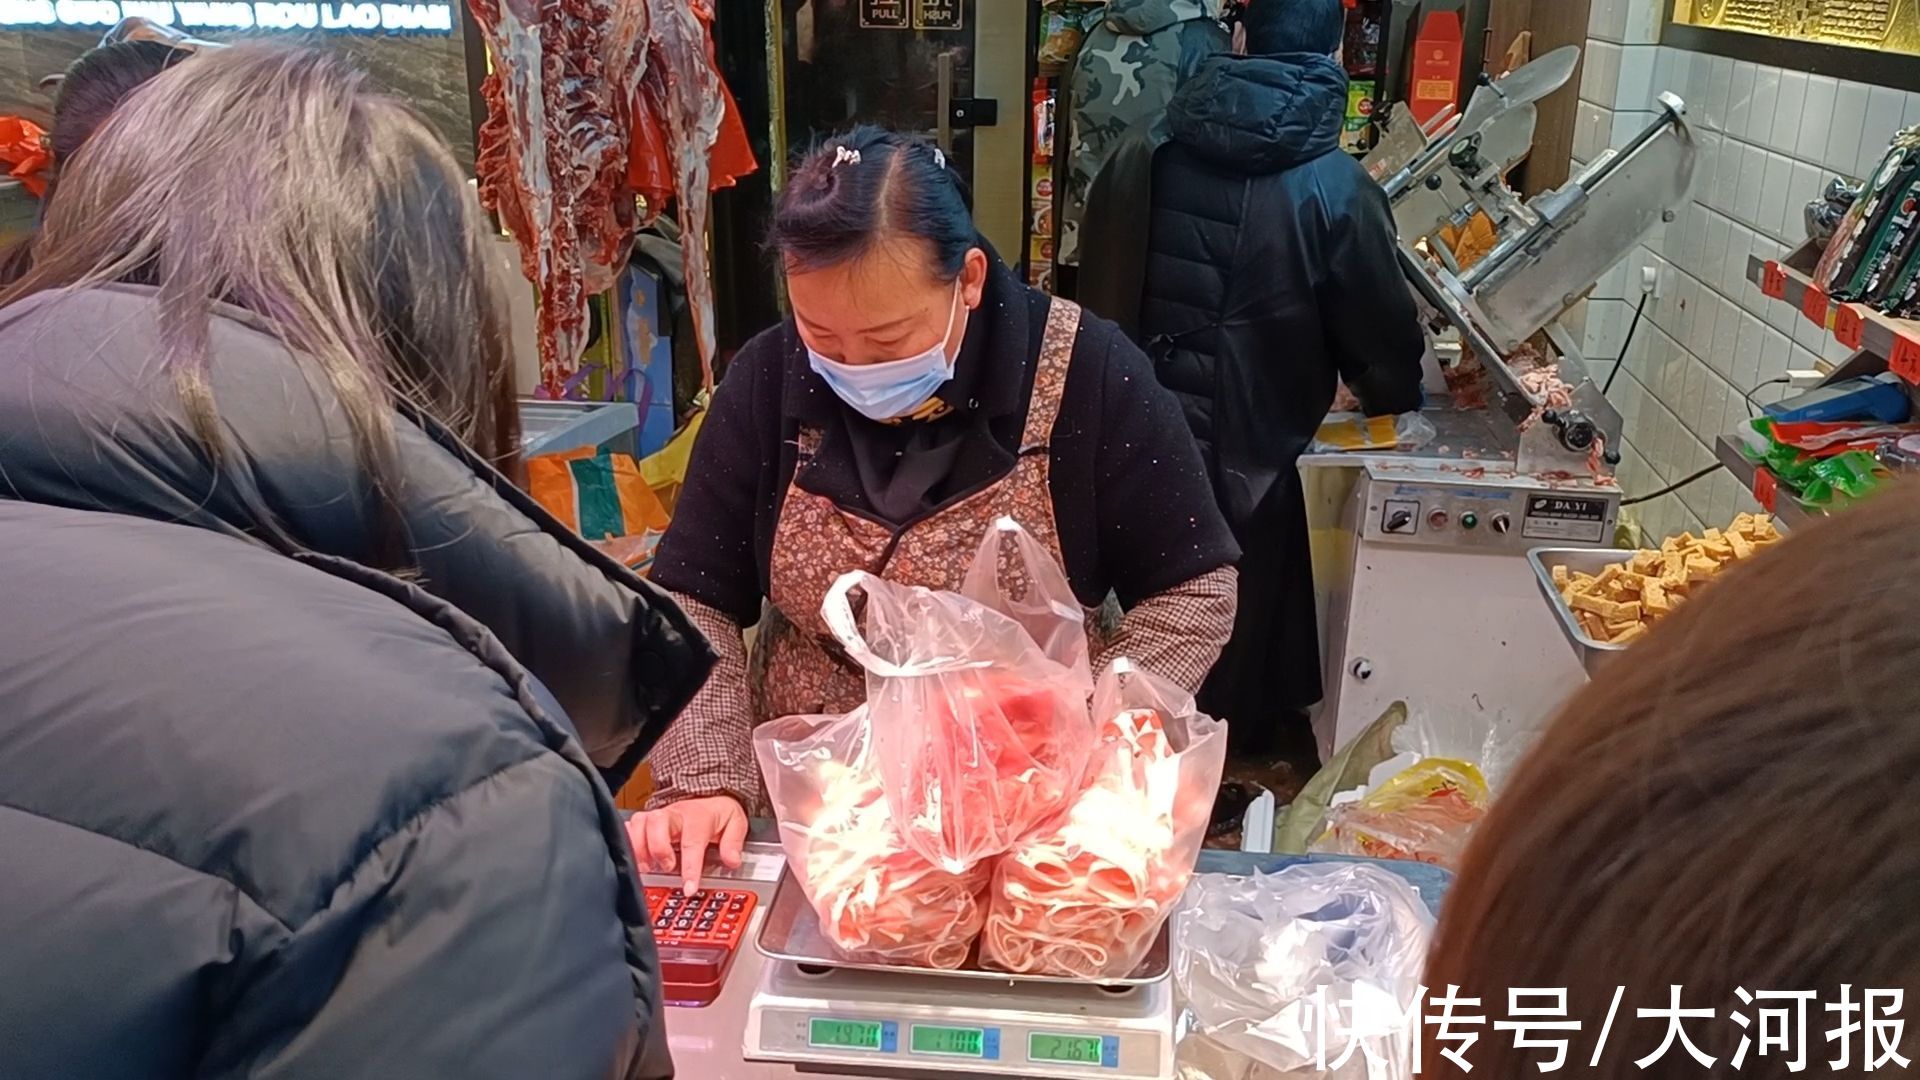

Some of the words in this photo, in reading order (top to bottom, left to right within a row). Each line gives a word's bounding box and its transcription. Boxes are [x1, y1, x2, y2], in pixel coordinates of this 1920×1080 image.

[255, 3, 318, 29] ROU
[321, 3, 381, 29] LAO
[381, 4, 451, 30] DIAN
[872, 9, 899, 19] PULL
